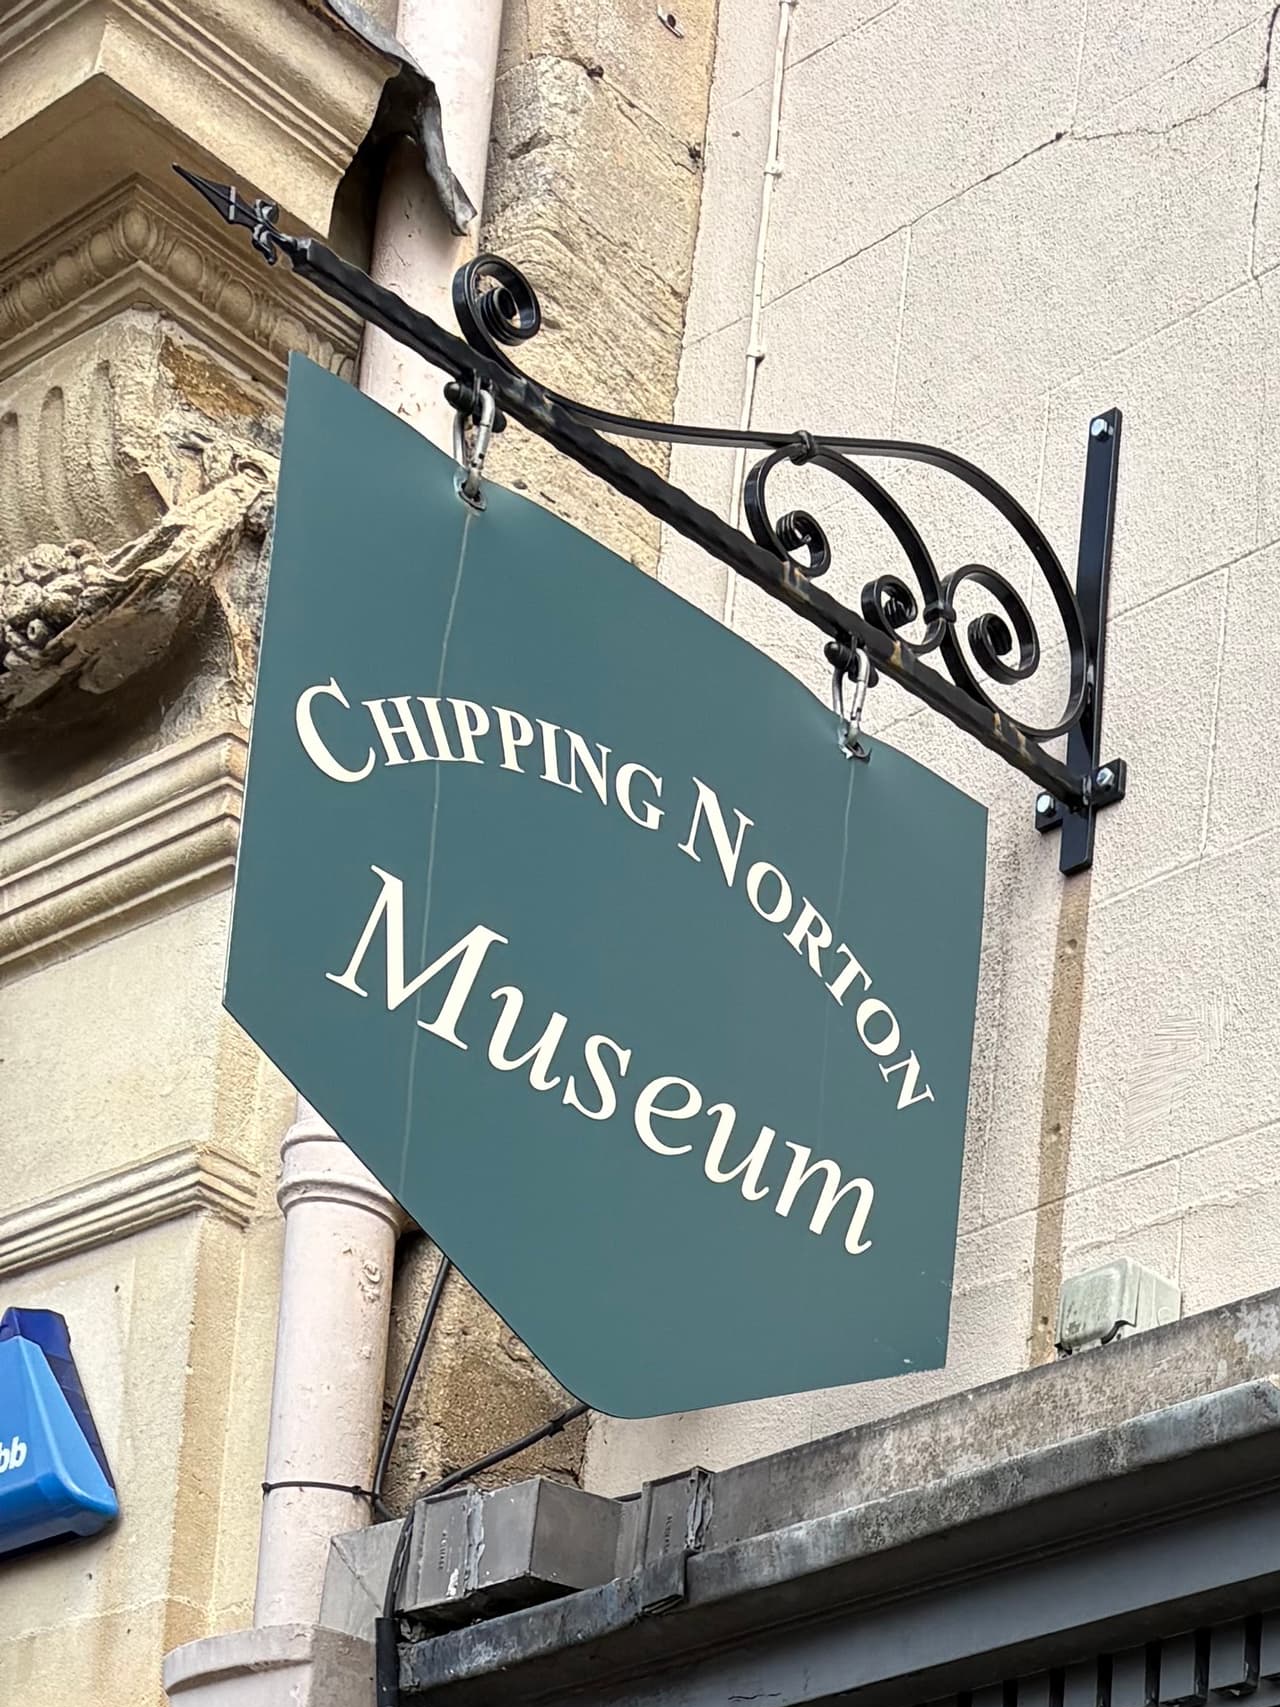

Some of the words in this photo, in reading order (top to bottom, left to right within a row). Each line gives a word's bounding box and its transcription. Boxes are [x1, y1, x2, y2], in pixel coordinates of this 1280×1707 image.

[295, 677, 664, 831] CHIPPING
[678, 777, 936, 1112] NORTON
[326, 864, 877, 1256] Museum
